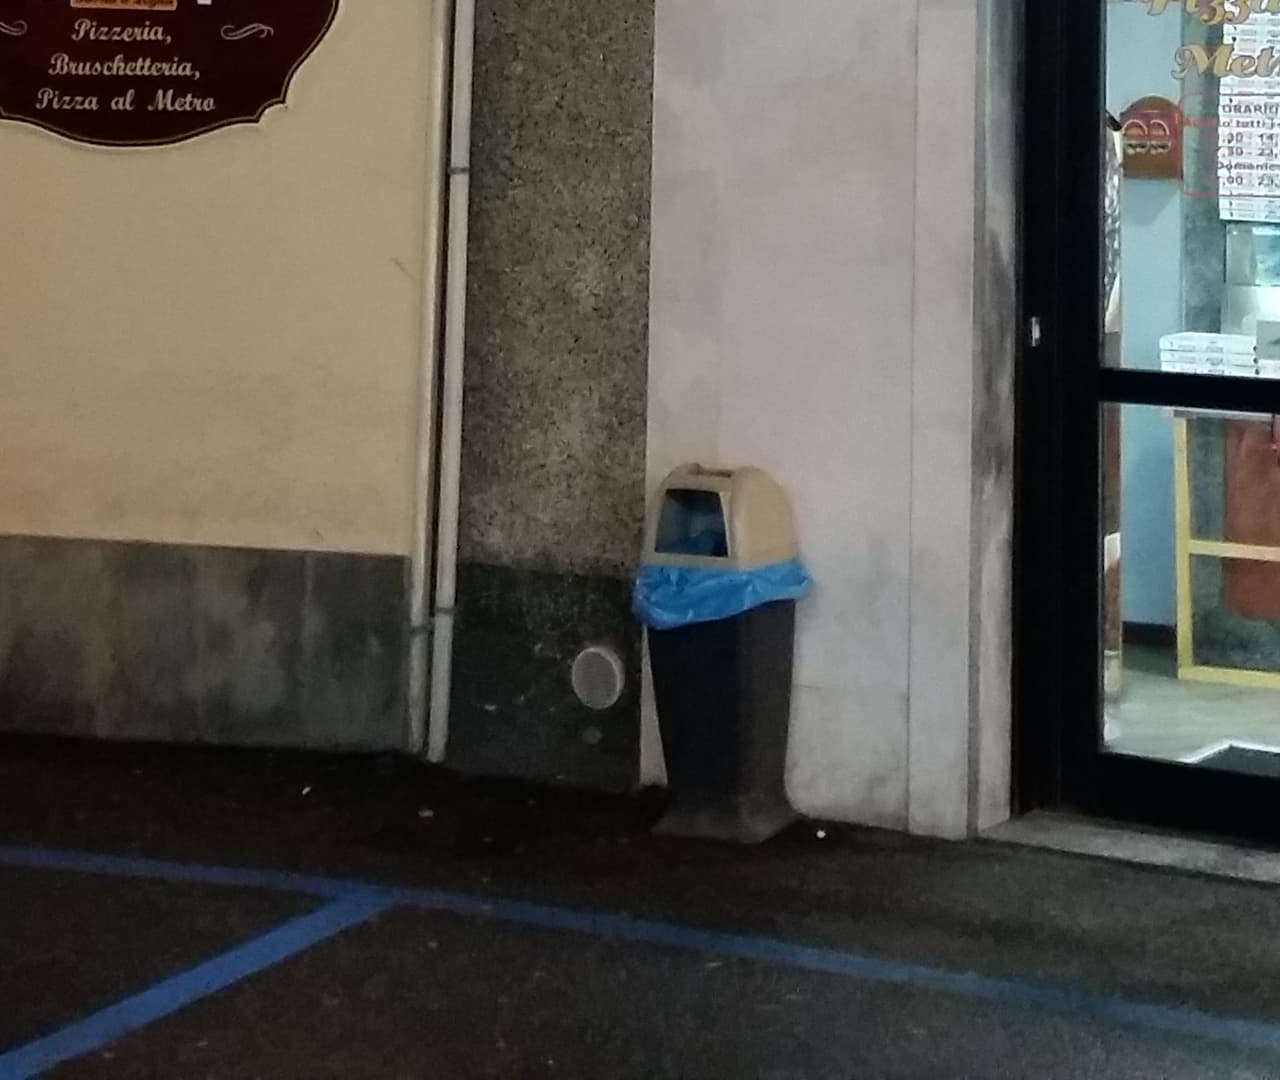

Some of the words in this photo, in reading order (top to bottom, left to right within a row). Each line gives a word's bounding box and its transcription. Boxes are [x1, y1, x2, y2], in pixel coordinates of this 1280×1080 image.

[72, 18, 172, 44] Pizzeria,
[48, 53, 201, 80] Bruschetteria,
[36, 88, 99, 111] Pizza
[110, 89, 135, 111] al
[148, 89, 216, 112] Metro
